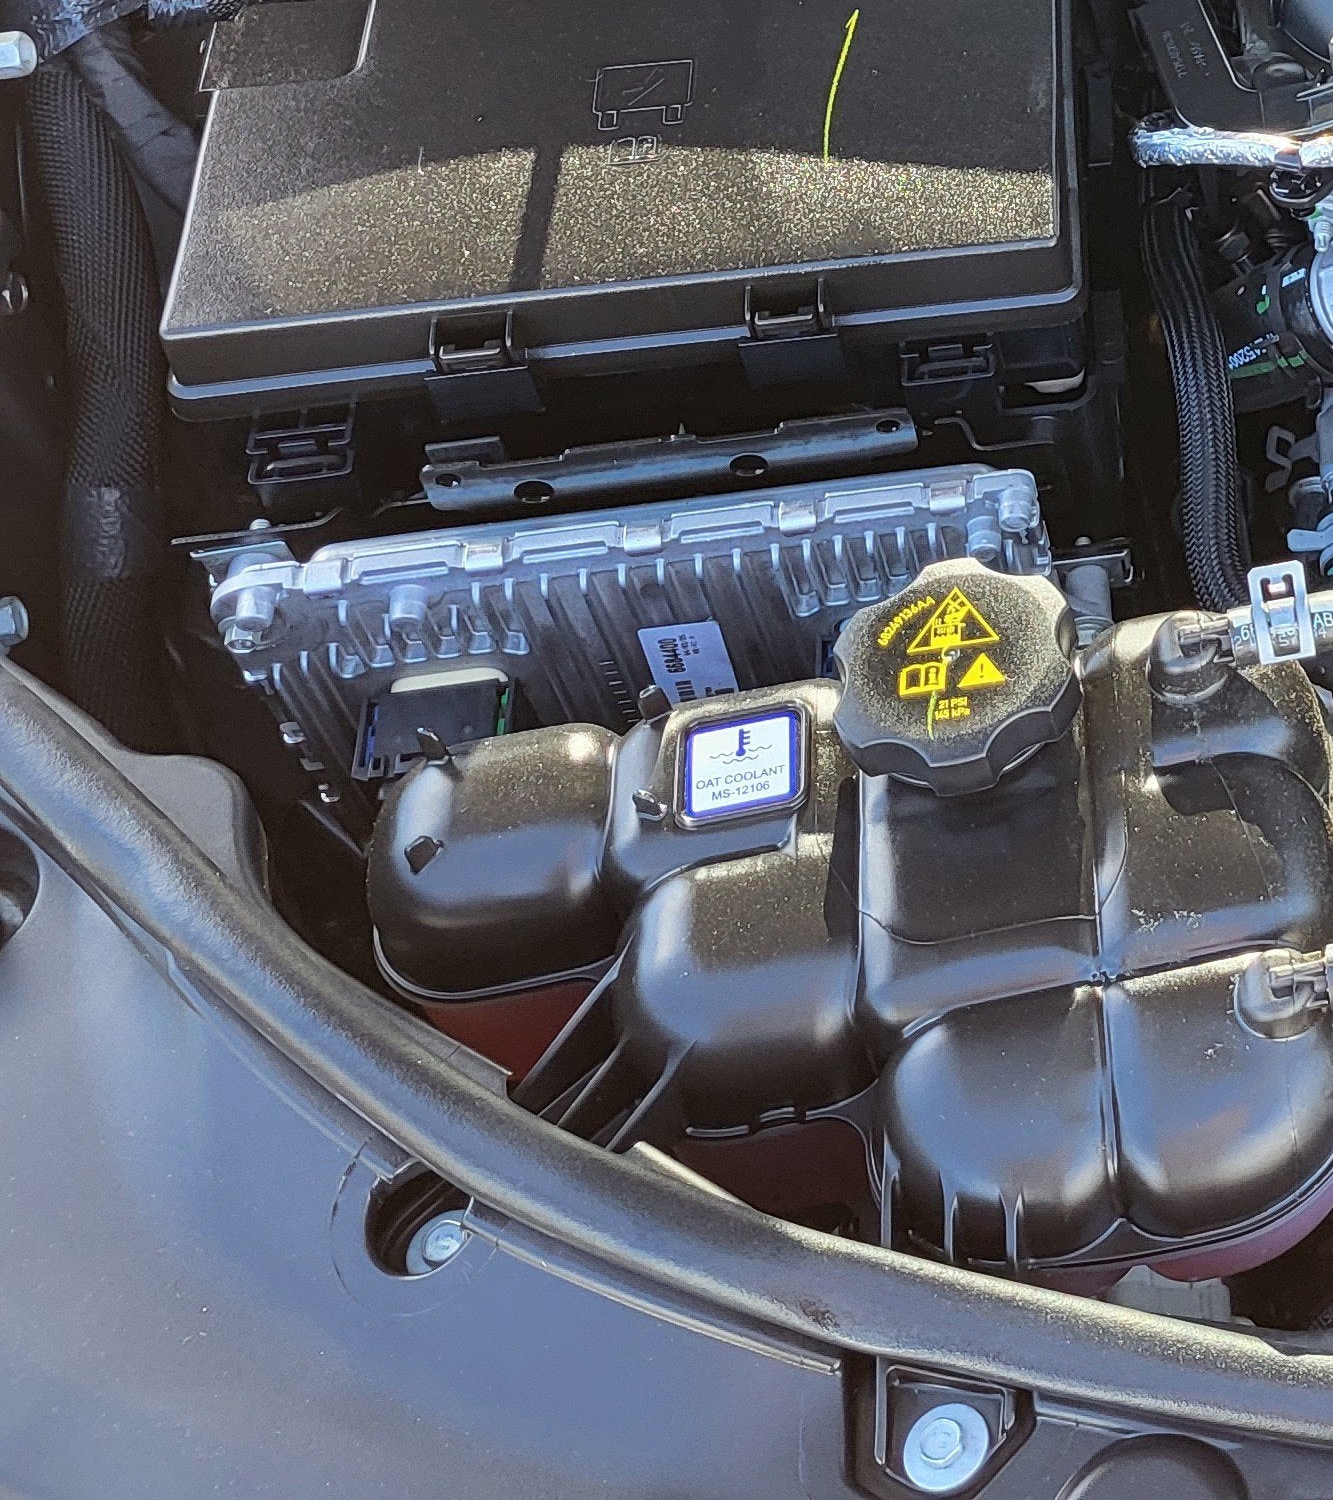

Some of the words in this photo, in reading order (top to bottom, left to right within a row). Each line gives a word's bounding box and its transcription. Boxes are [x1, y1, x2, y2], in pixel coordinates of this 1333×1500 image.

[877, 595, 936, 646] 68249136AA
[935, 709, 950, 720] 145
[950, 707, 971, 718] kPa
[939, 699, 949, 709] 21
[950, 697, 968, 708] PSI
[696, 777, 722, 790] OAT
[724, 764, 786, 785] COOLANT
[712, 780, 771, 801] MS-12106
